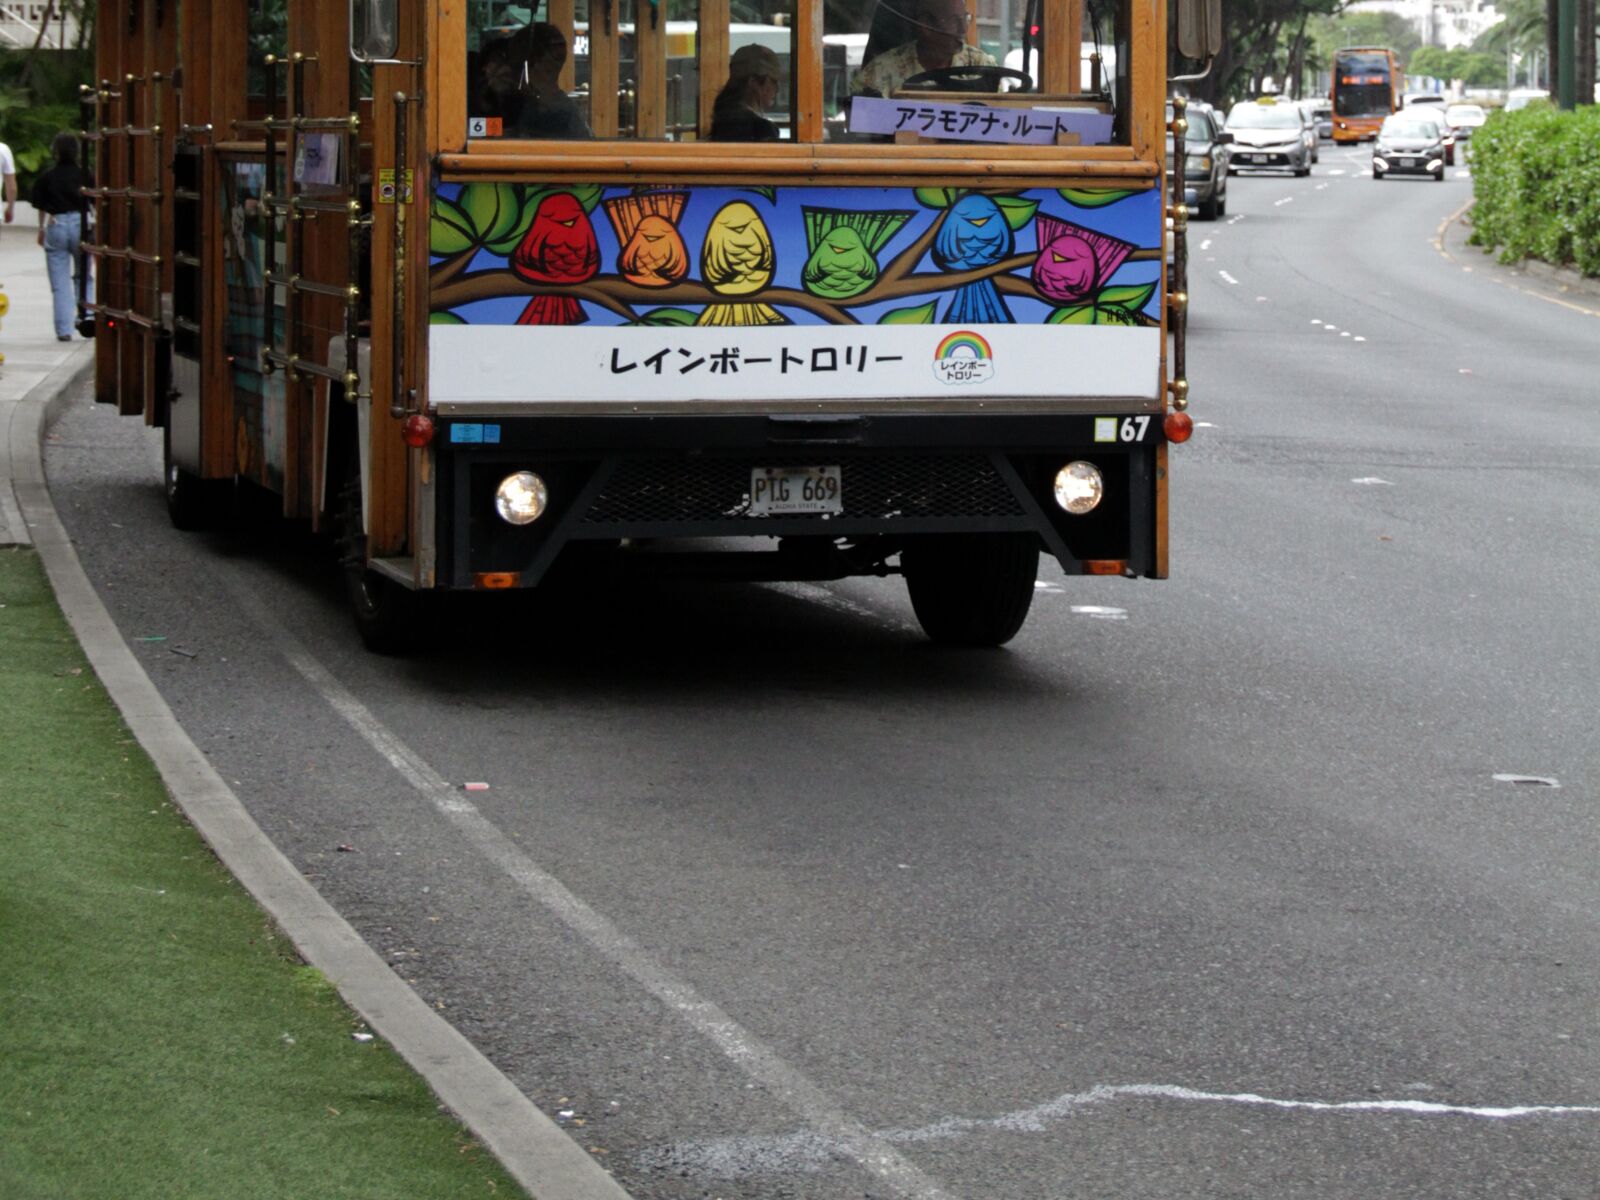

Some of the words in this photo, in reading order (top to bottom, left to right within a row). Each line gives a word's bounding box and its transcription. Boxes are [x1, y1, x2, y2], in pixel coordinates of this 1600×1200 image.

[473, 121, 482, 132] 6
[895, 106, 1069, 138] アラモアナ・ルート
[610, 345, 904, 375] レインボートロリー
[941, 361, 987, 371] レインボー
[946, 371, 982, 380] トロリー
[1120, 415, 1151, 442] 67
[755, 477, 790, 502] PTG
[802, 476, 838, 502] 669
[798, 502, 818, 510] STATE
